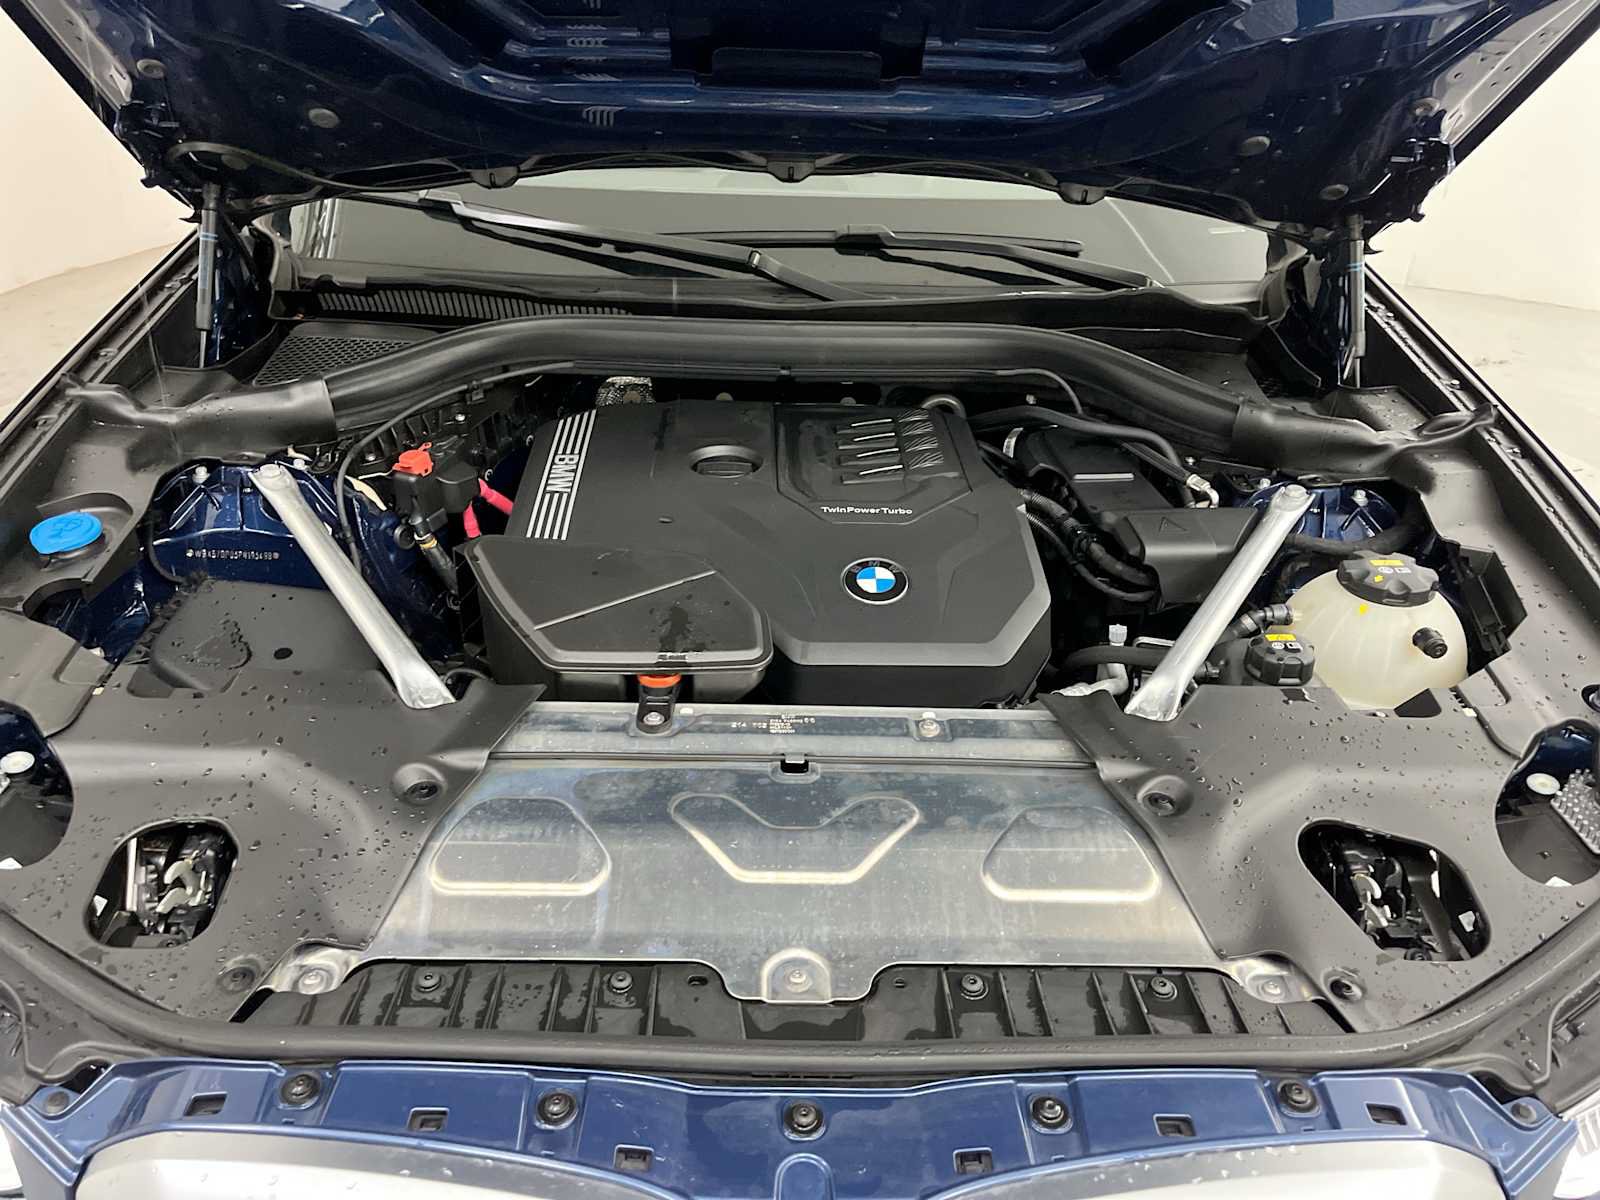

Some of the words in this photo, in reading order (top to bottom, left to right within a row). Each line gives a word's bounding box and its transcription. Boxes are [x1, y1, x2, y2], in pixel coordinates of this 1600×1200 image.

[546, 454, 580, 492] BMW
[820, 506, 880, 514] TwinPower
[850, 560, 902, 573] BMW
